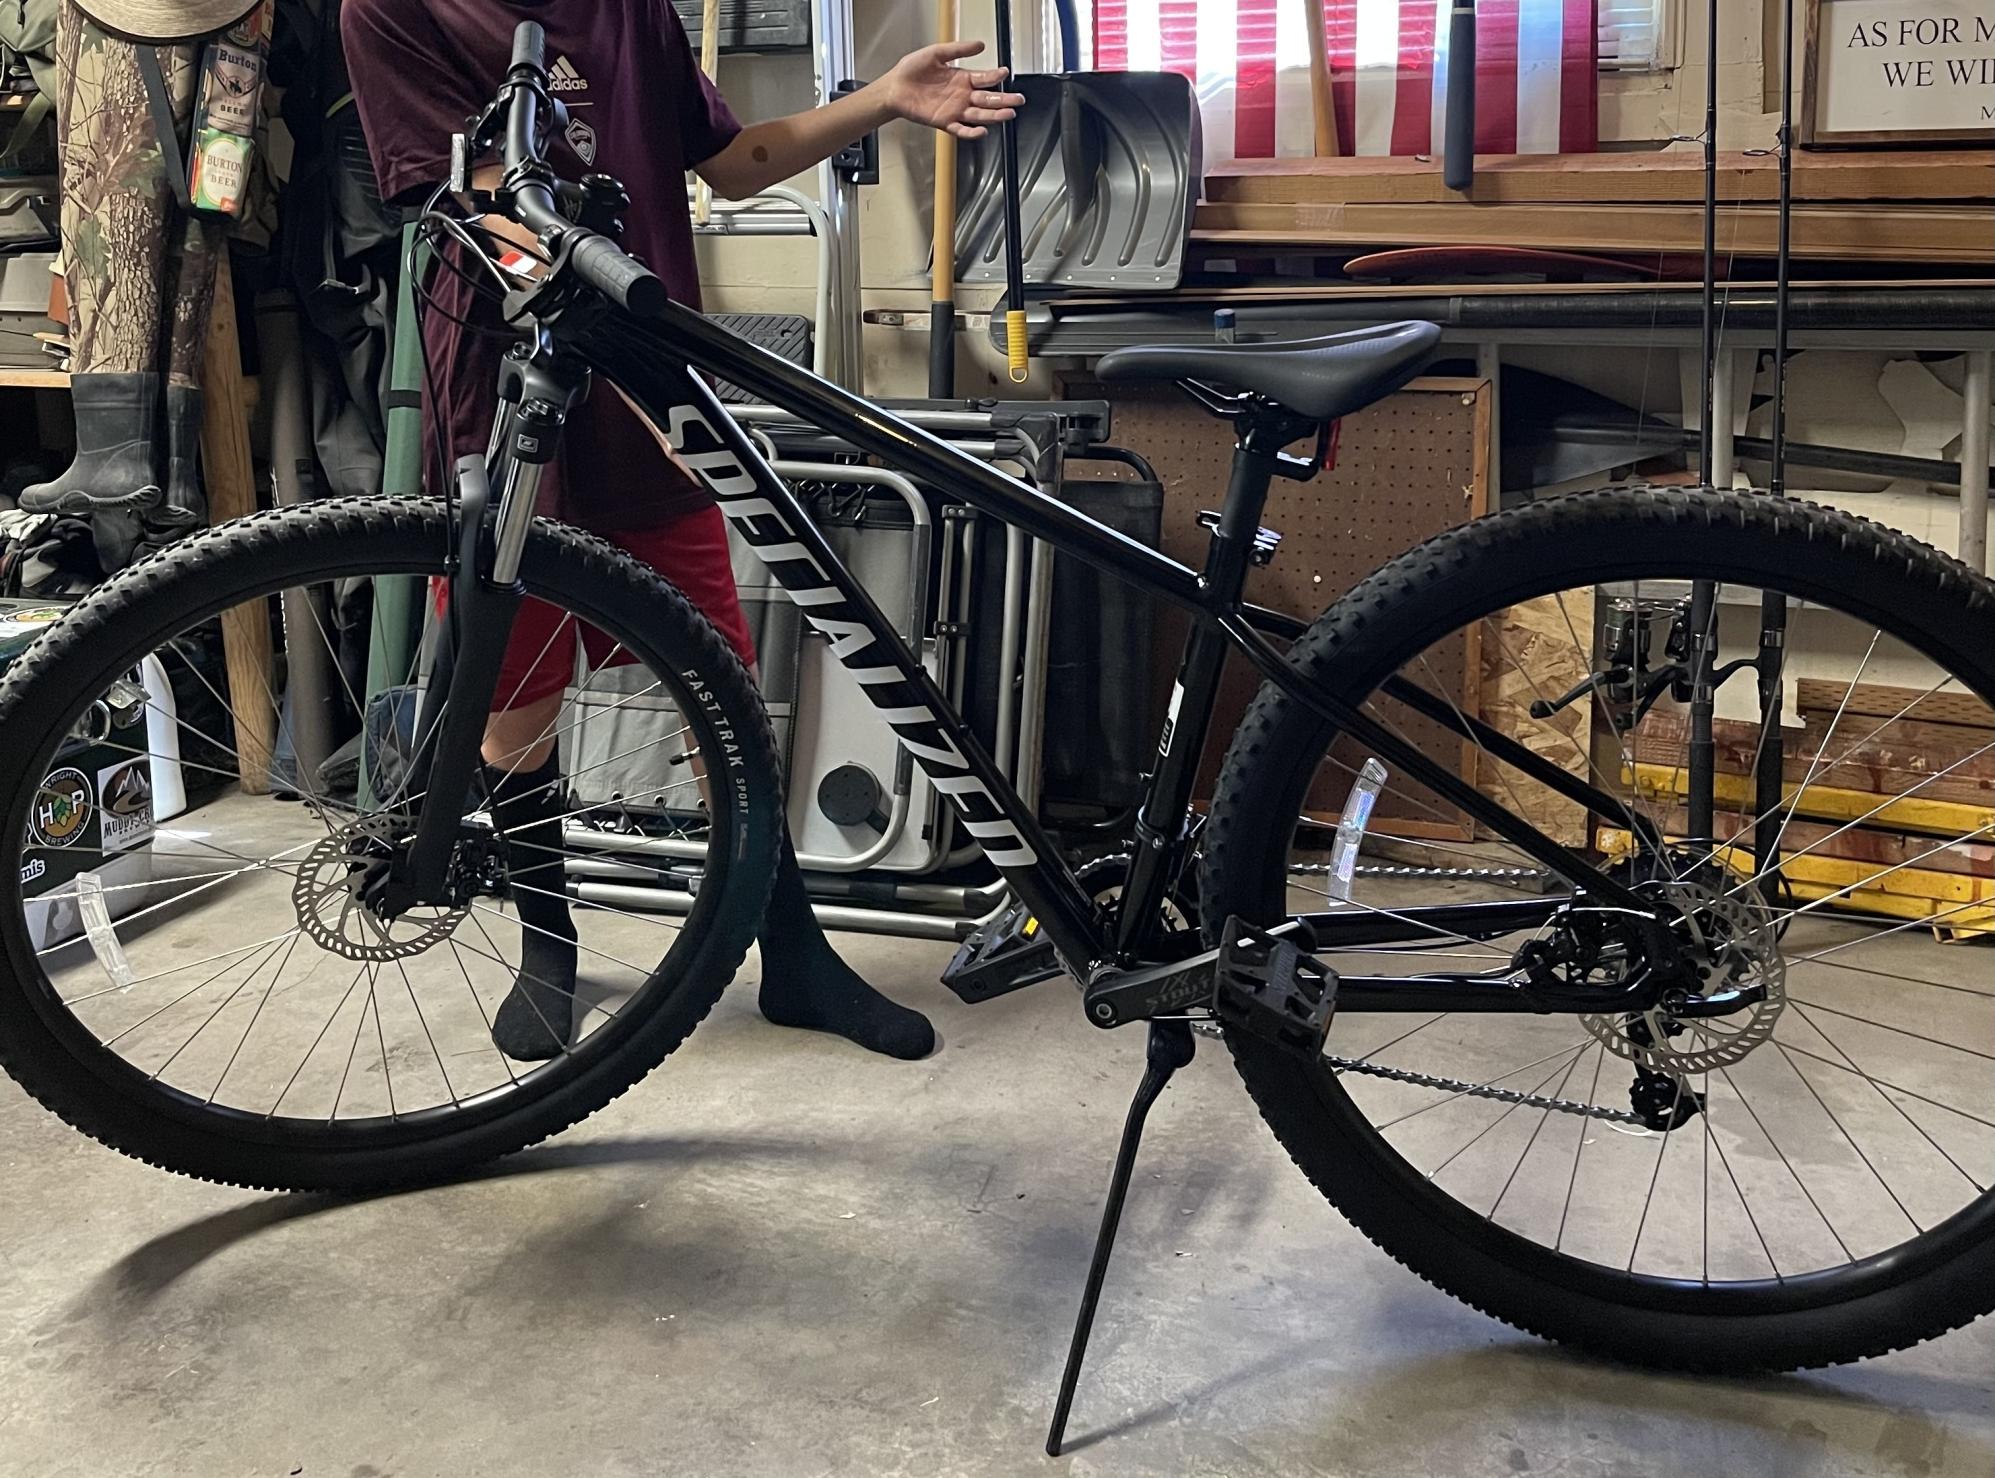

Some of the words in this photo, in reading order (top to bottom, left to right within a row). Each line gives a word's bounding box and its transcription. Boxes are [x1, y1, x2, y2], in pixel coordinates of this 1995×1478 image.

[1847, 21, 1888, 48] AS
[1897, 18, 1962, 46] FOR
[218, 49, 257, 72] Burton
[1882, 60, 1935, 87] WE
[207, 155, 242, 172] BURTON
[210, 174, 237, 189] BEER
[668, 404, 1038, 867] SPECIALIZED
[681, 669, 722, 712] FAST
[714, 716, 744, 767] TRAK
[736, 778, 749, 815] SPORT
